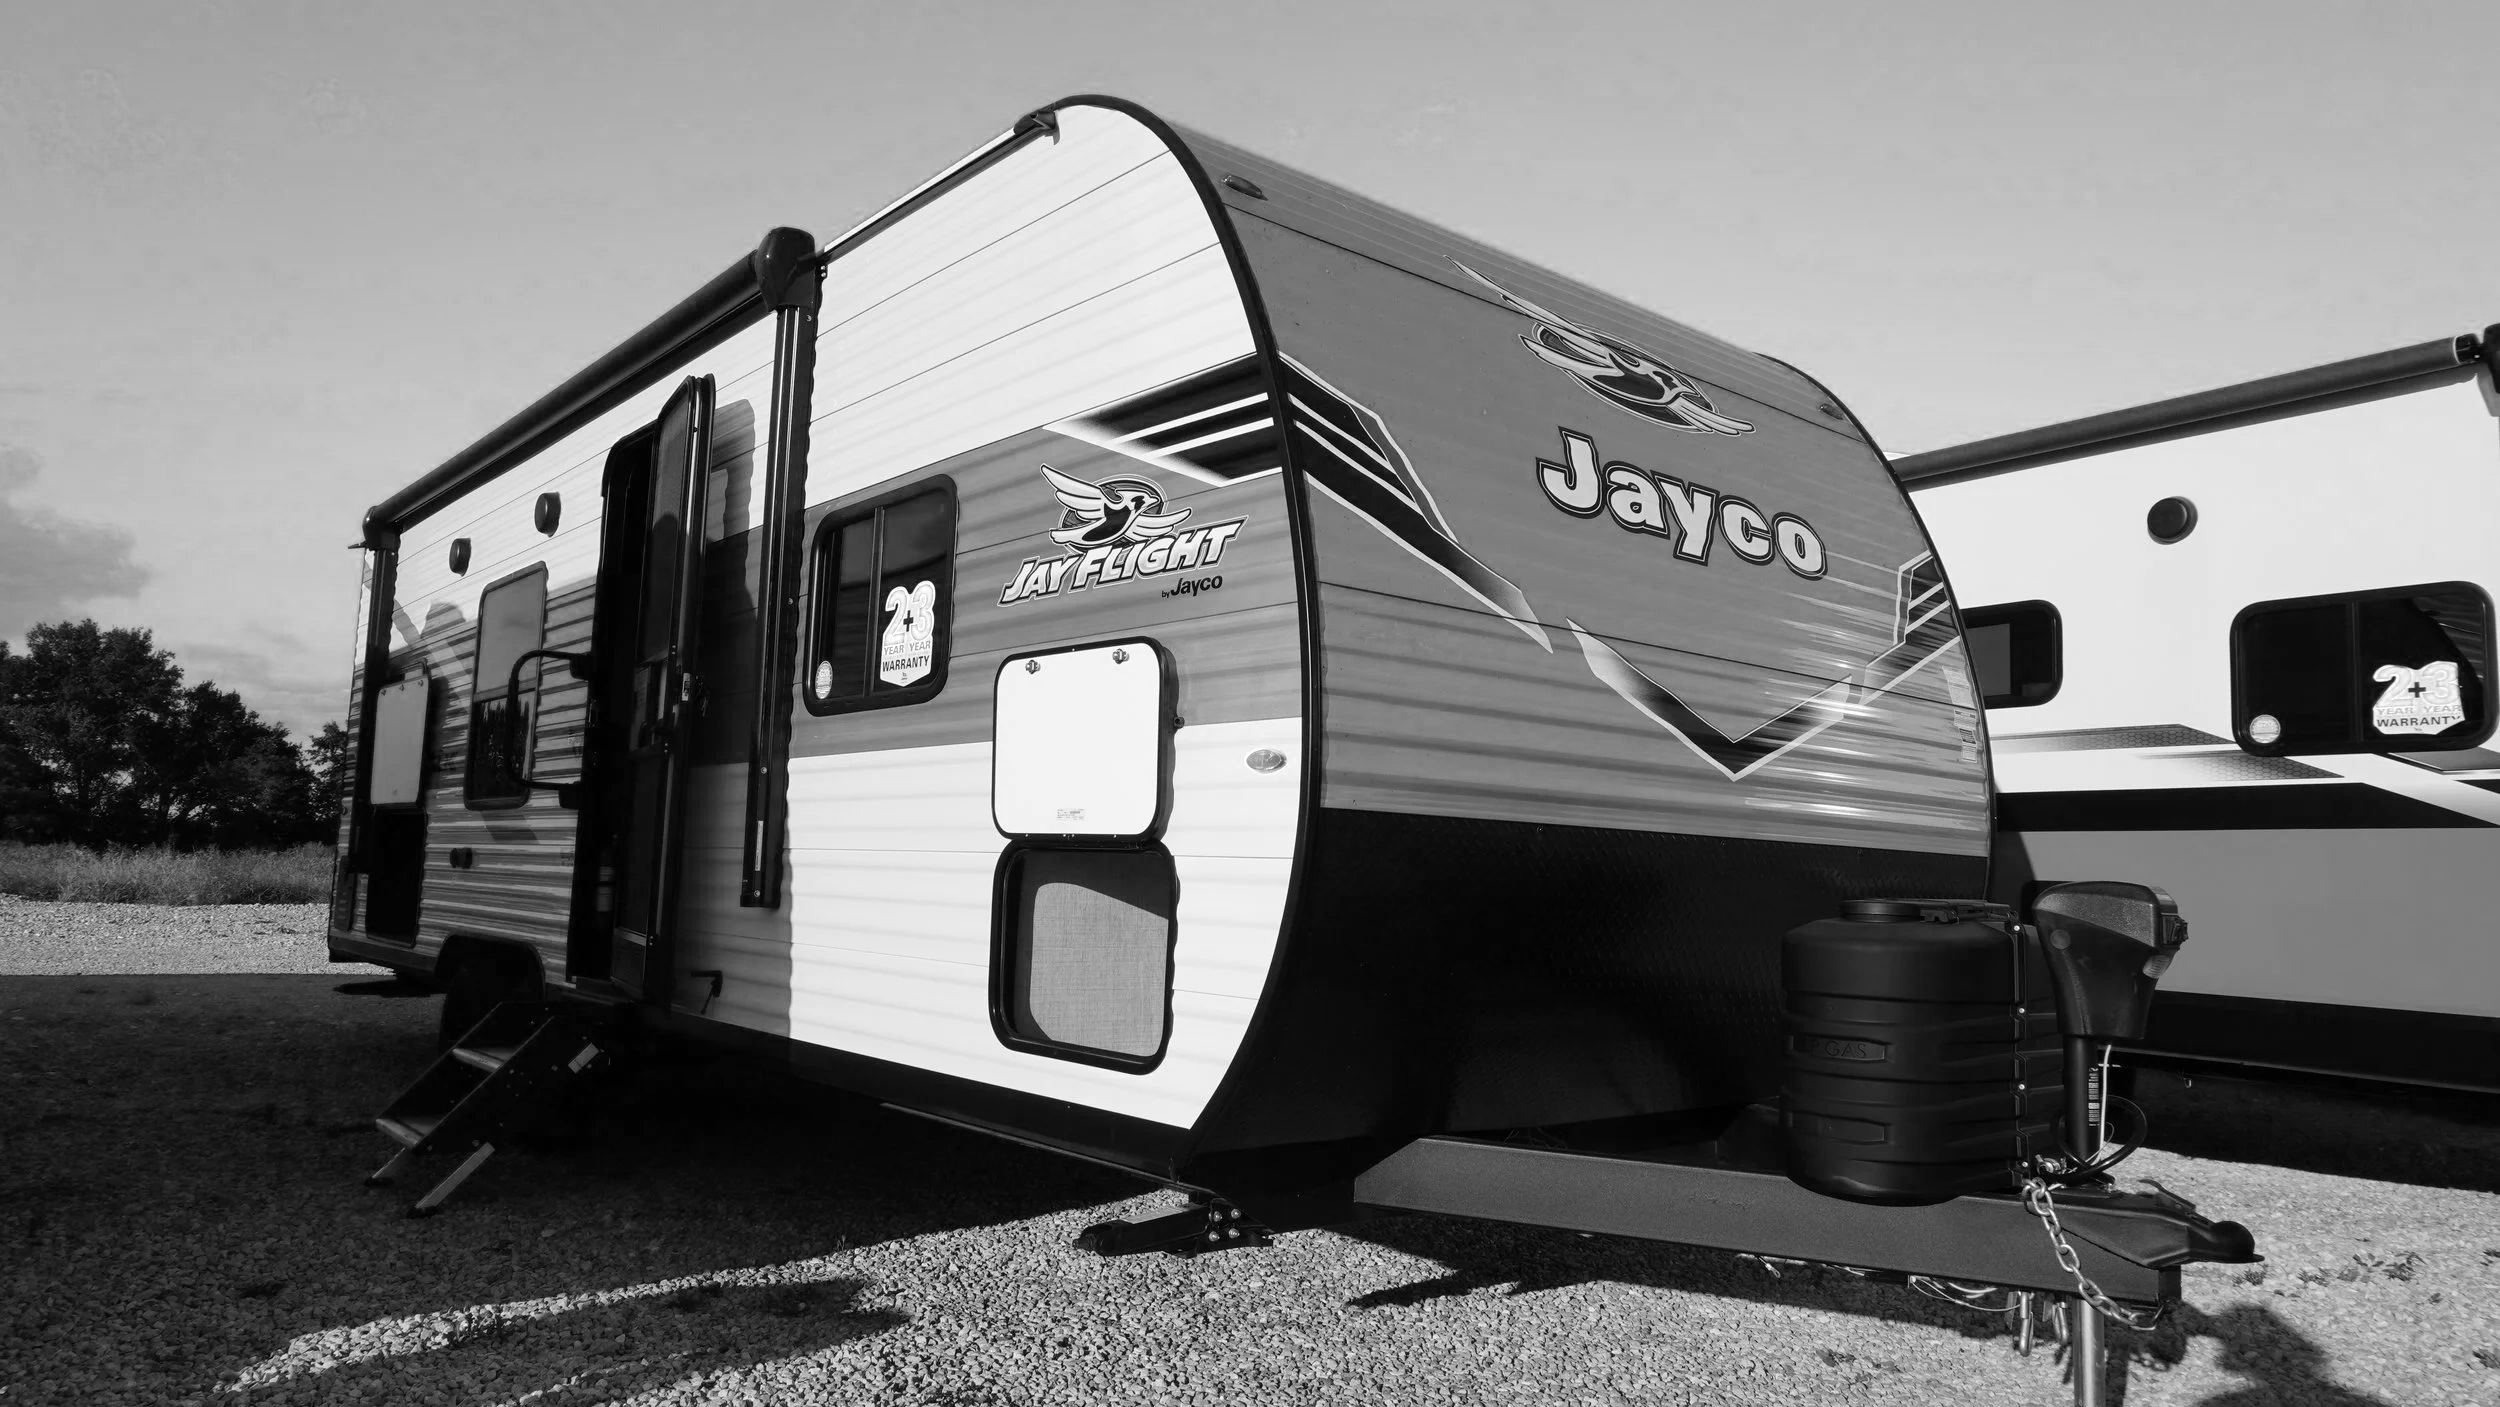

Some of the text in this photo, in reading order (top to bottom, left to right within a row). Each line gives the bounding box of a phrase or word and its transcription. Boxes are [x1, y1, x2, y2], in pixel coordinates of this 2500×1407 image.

[1536, 426, 1828, 581] Jayco
[998, 516, 1248, 607] JAY FLIGHT
[1161, 575, 1223, 599] by Jayco
[884, 640, 931, 656] YEAR YEAR
[882, 655, 930, 672] WARRANTY
[2376, 704, 2461, 716] YEAR YEAR
[1825, 1040, 1867, 1058] GAS
